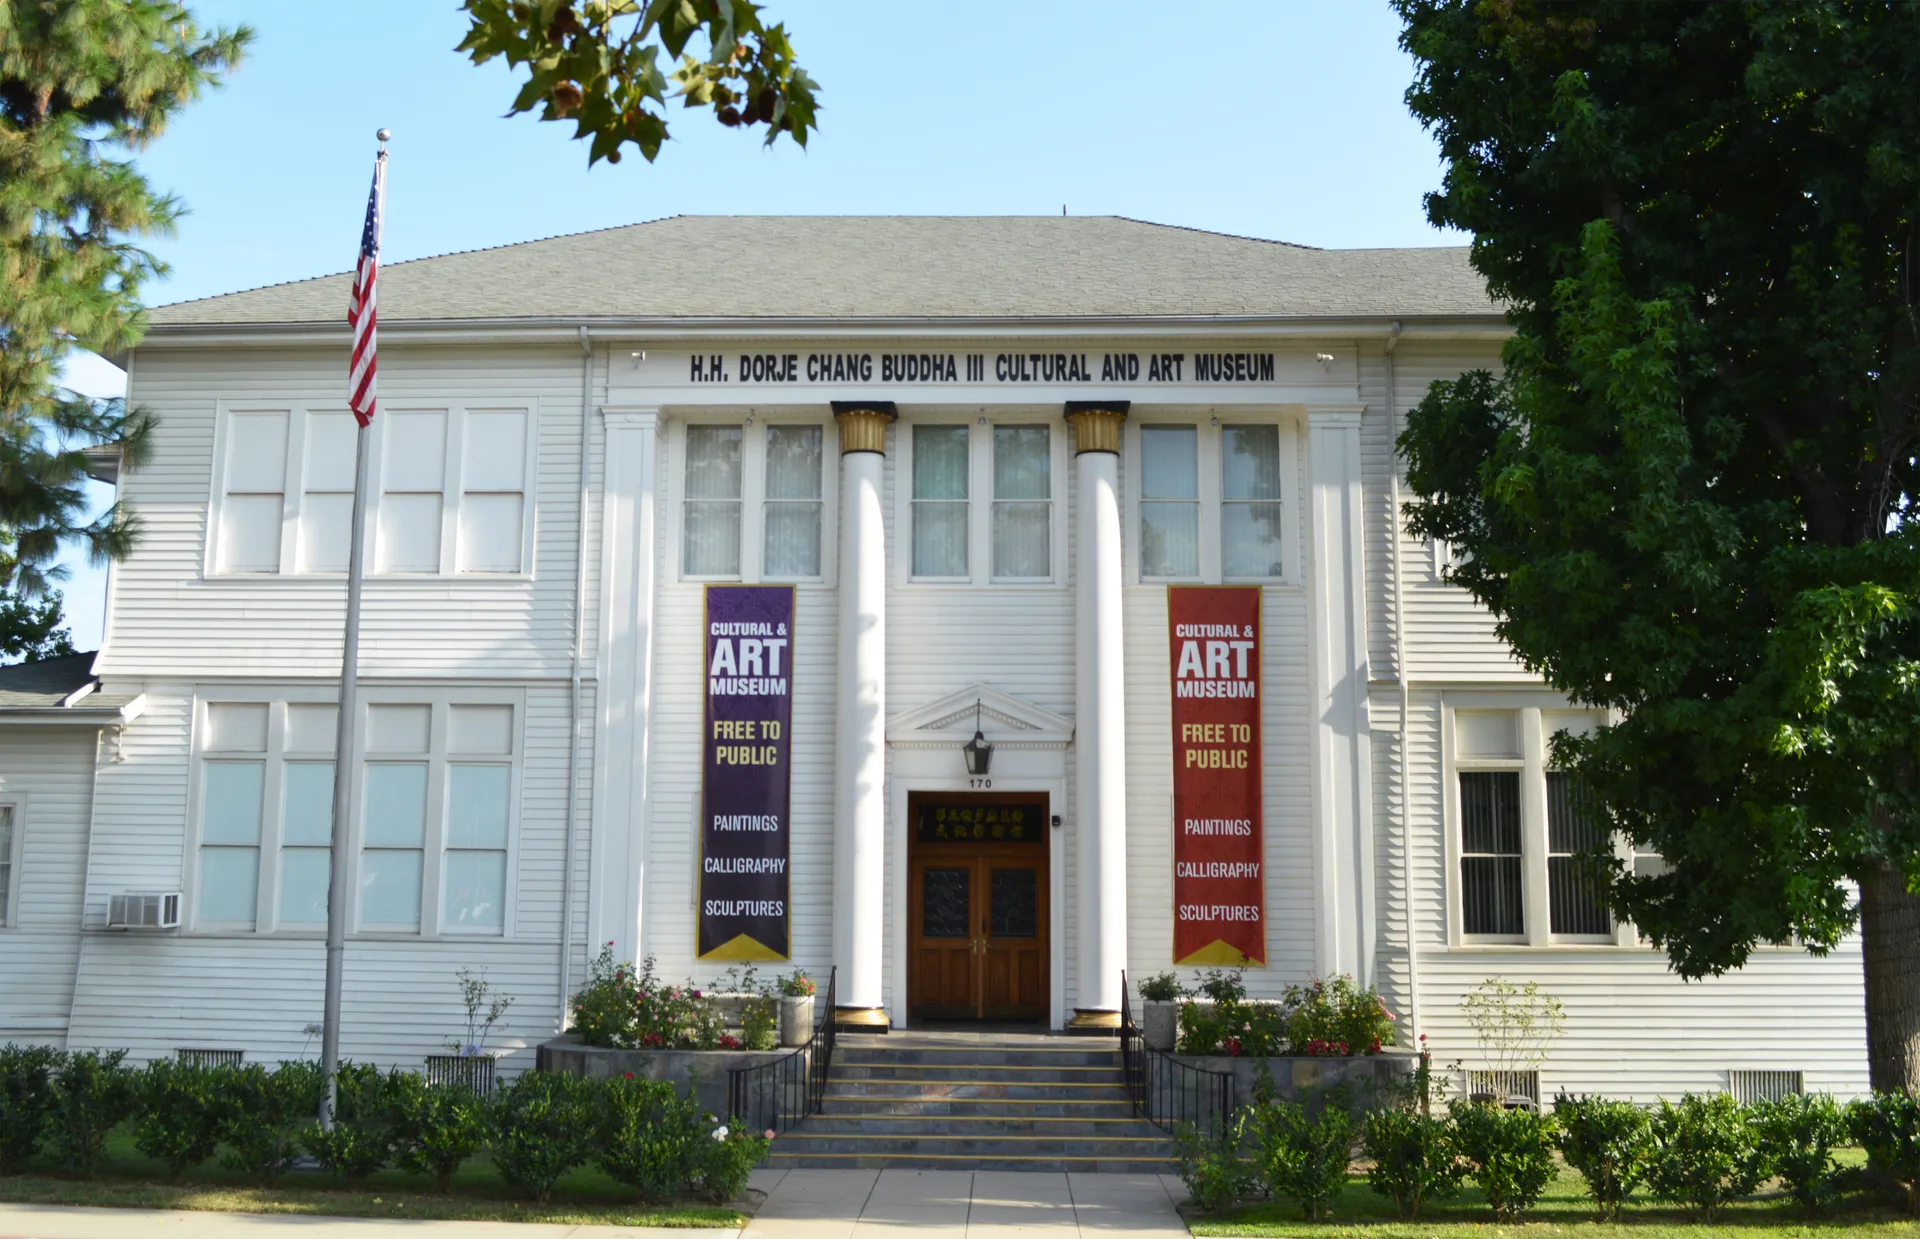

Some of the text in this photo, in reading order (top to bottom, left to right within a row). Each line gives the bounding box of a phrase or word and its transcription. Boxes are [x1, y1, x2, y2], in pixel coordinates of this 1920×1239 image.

[690, 353, 1275, 382] H.H. DORJE CHANG BUDDHA III CULTURAL AND ART MUSEUM
[711, 622, 787, 636] CULTURAL &
[1176, 623, 1254, 638] CULTURAL &
[710, 638, 788, 676] ART
[1176, 640, 1255, 679] ART
[710, 678, 786, 696] MUSEUM
[1176, 680, 1255, 698] MUSEUM
[713, 720, 781, 740] FREE TO
[1182, 723, 1251, 743] FREE TO
[716, 746, 777, 765] PUBLIC
[1186, 749, 1248, 769] PUBLIC
[969, 779, 992, 788] 170
[713, 815, 778, 832] PAINTINGS
[1184, 818, 1251, 836] PAINTINGS
[704, 857, 786, 874] CALLIGRAPHY
[1177, 861, 1260, 878] CALLIGRAPHY
[705, 900, 784, 917] SCULPTURES
[1179, 904, 1259, 921] SCULPTURES
